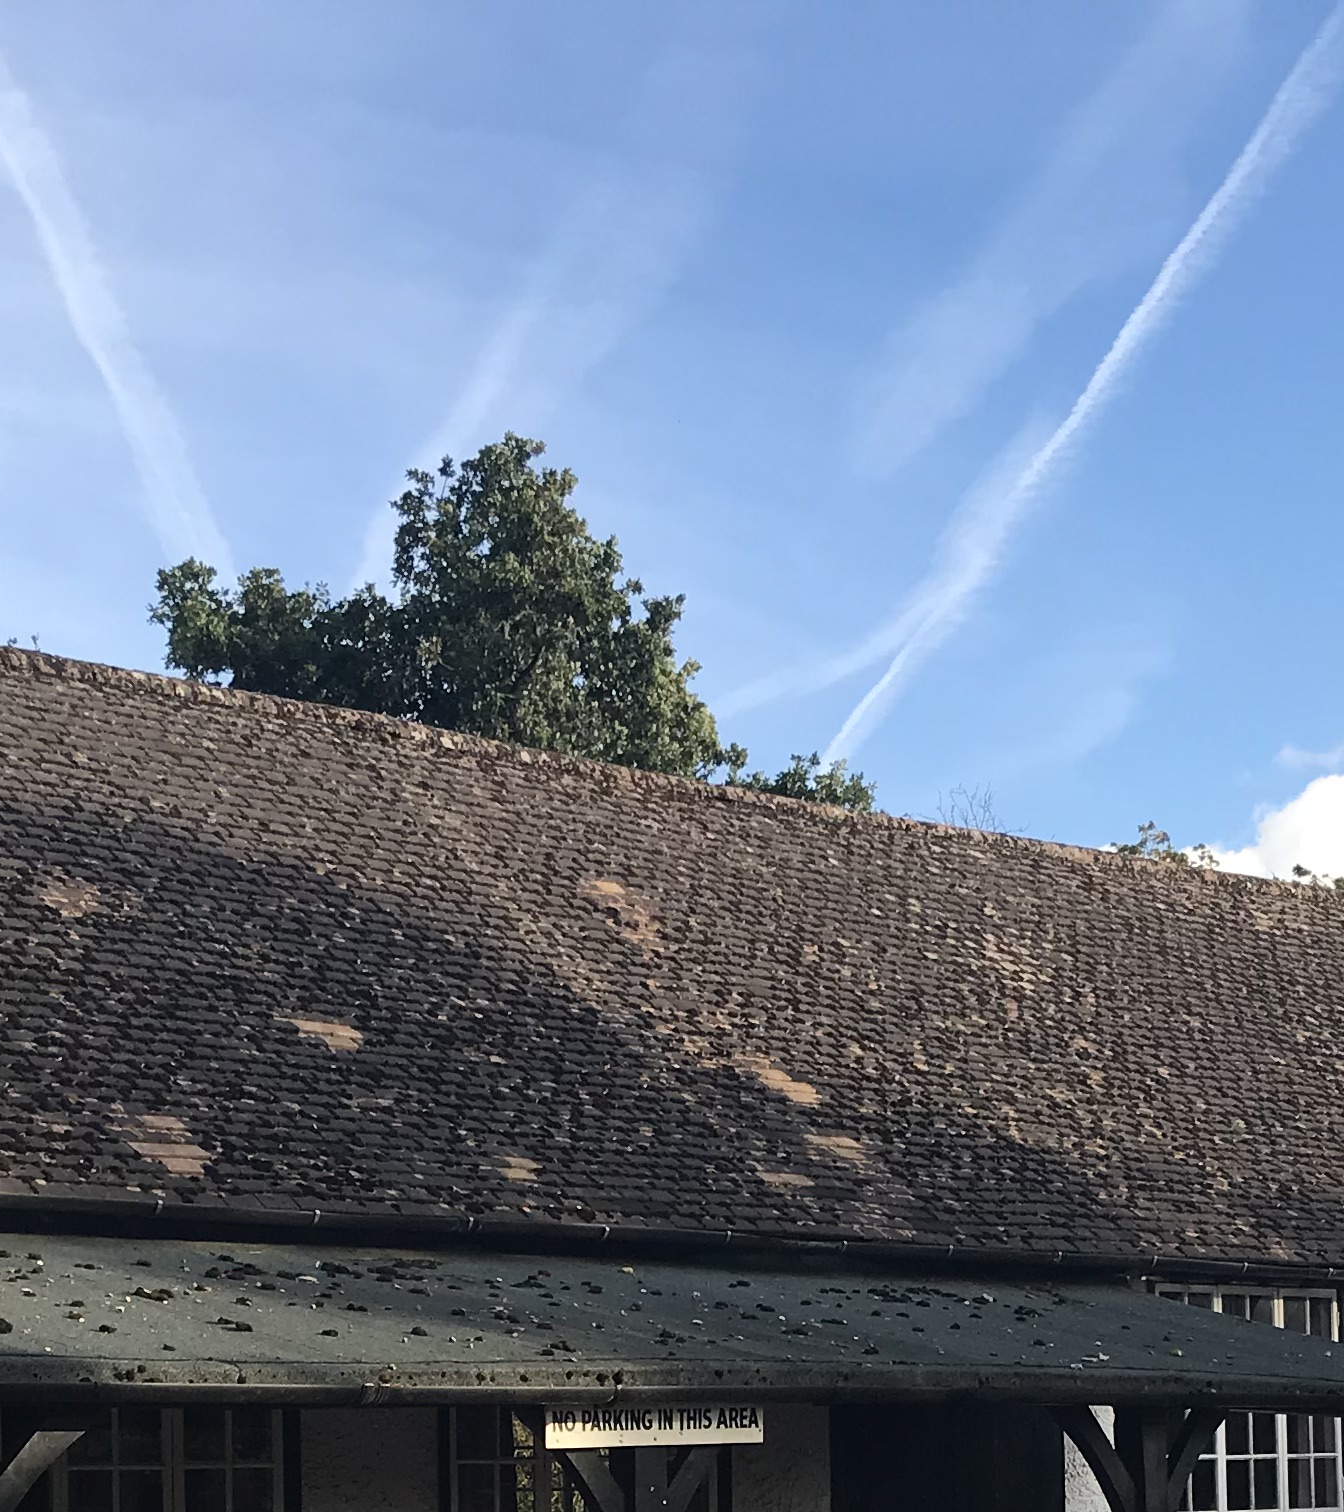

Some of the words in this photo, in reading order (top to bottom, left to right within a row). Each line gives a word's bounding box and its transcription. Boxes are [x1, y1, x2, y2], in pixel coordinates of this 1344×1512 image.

[552, 1410, 576, 1432] NO
[582, 1409, 653, 1432] PARKING
[658, 1408, 674, 1431] IN
[678, 1408, 712, 1431] THIS
[716, 1407, 760, 1429] AREA
